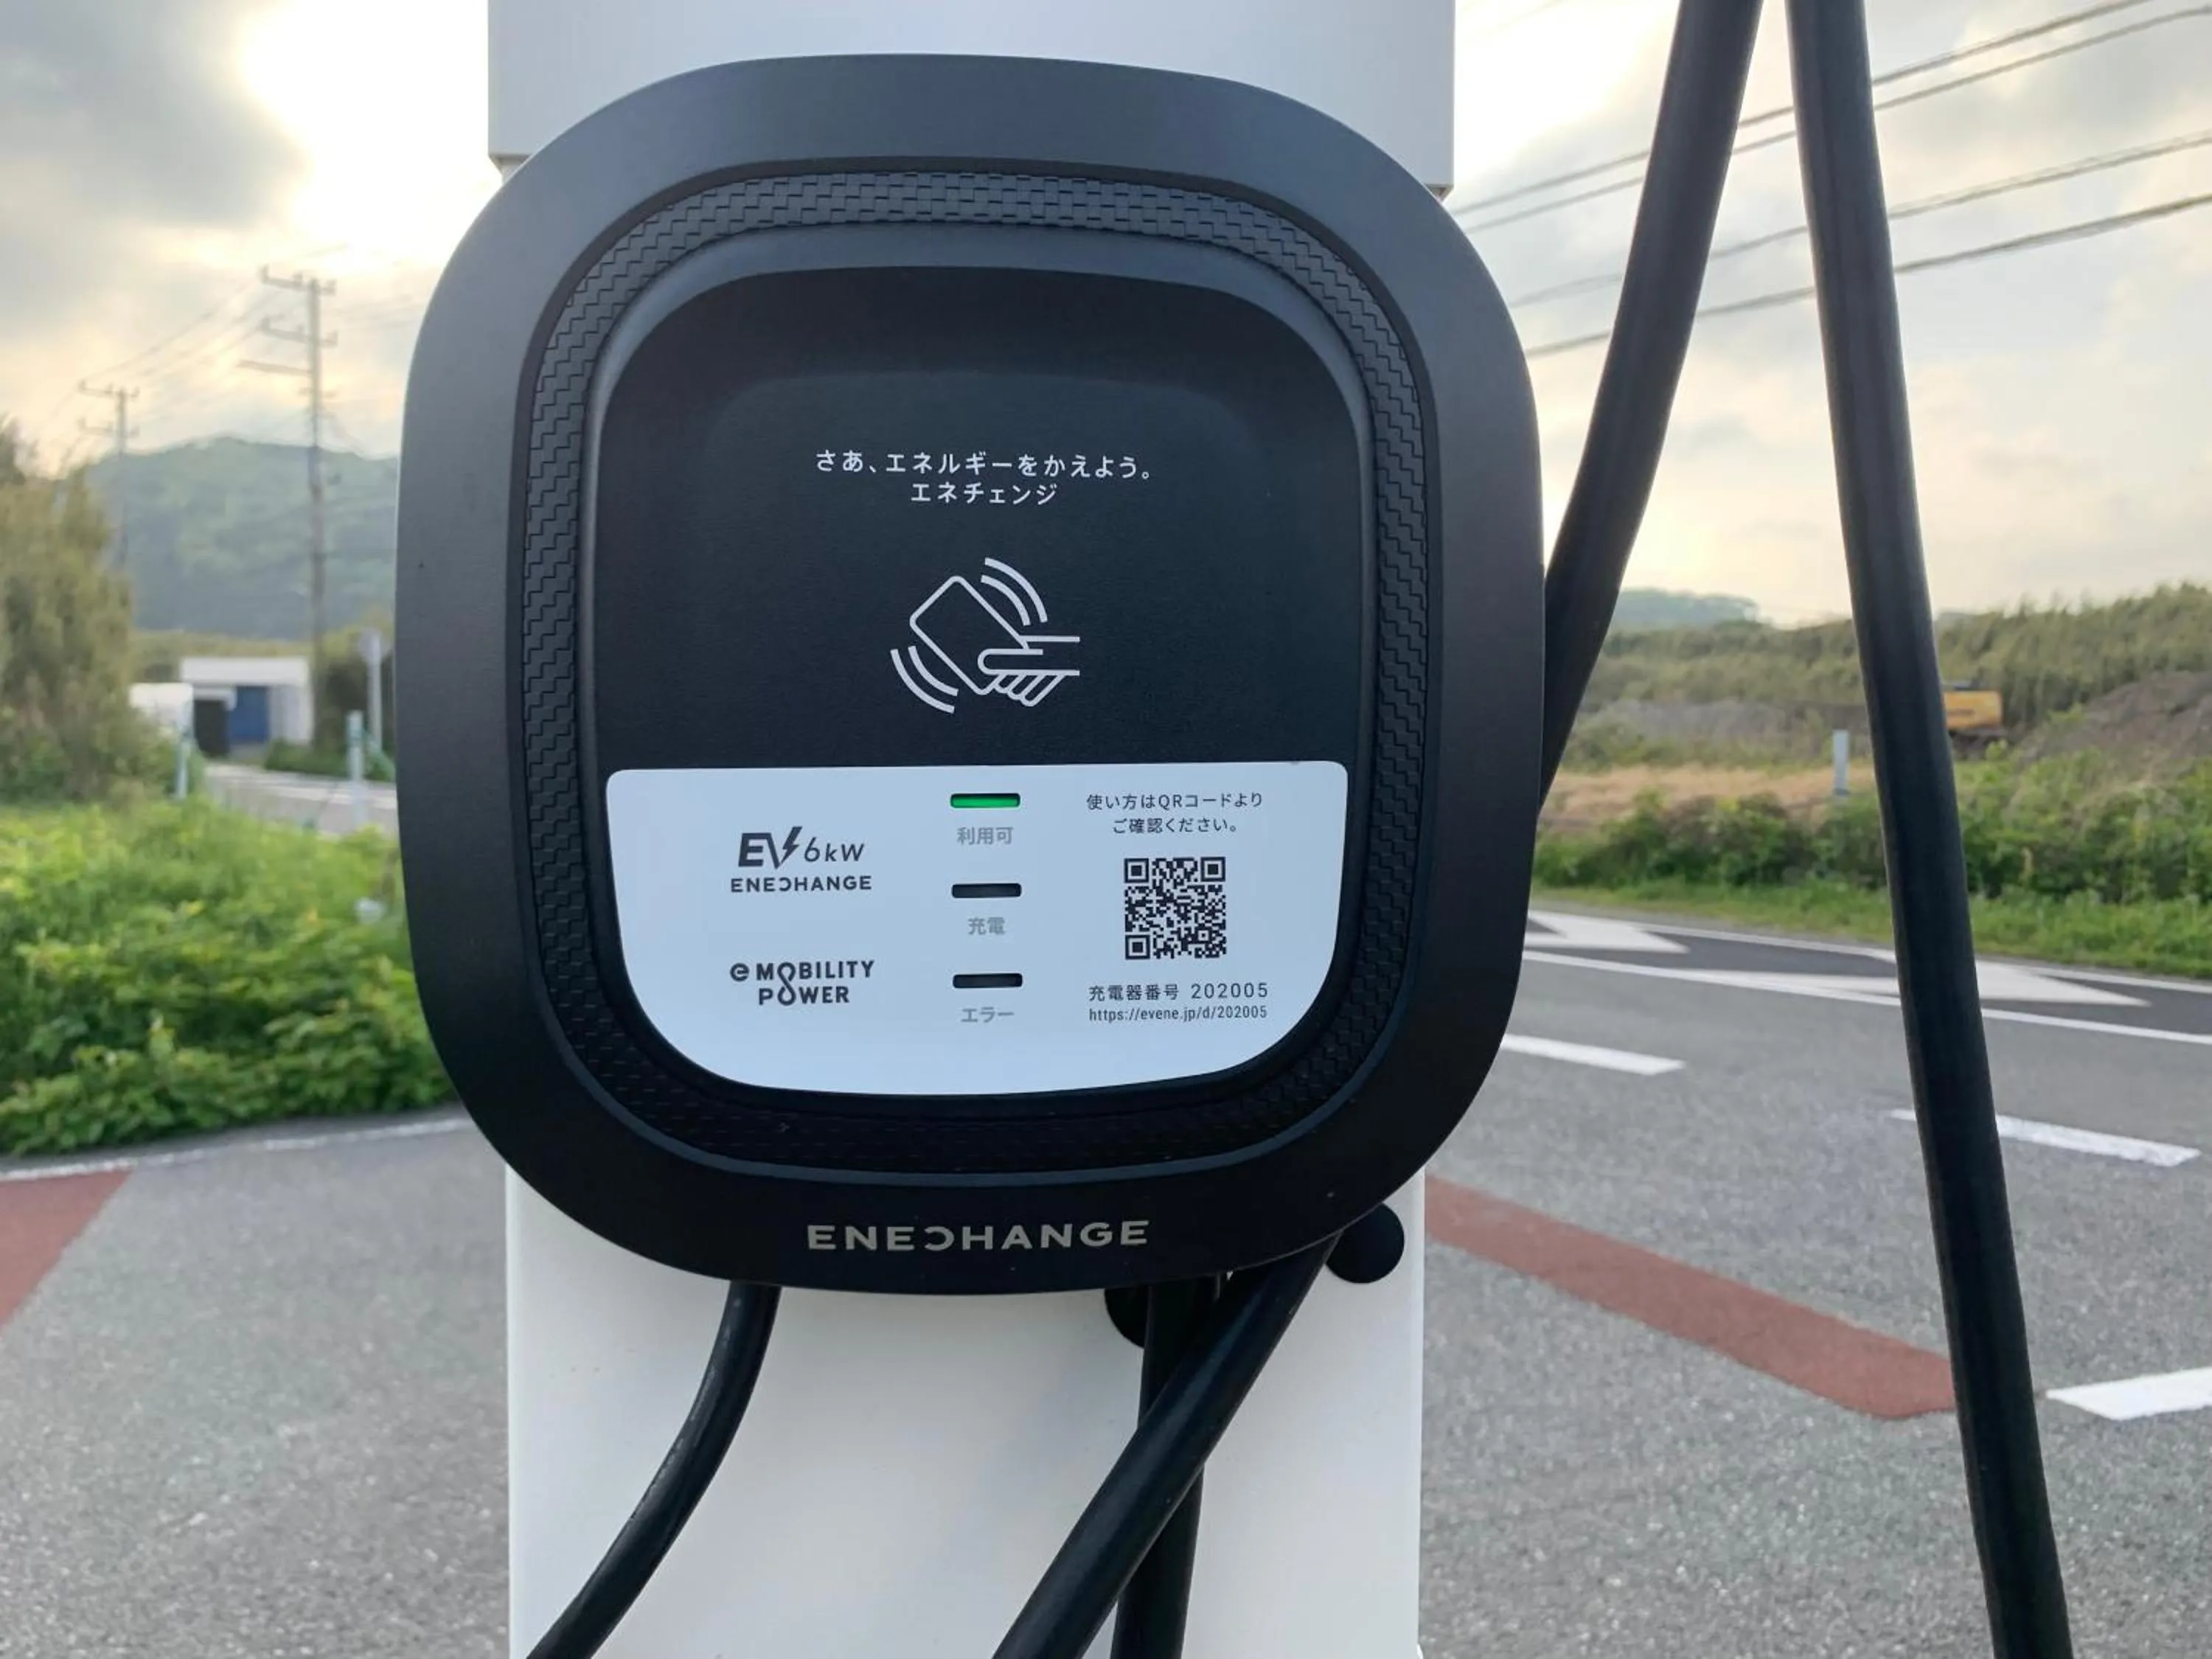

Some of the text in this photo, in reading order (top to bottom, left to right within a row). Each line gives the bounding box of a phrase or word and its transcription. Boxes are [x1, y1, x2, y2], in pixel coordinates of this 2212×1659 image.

[815, 449, 1150, 480] さあ、エネルギーをかえよう。
[911, 481, 1057, 505] エネチェンジ
[1086, 792, 1262, 811] 使い方はQRコードより
[1113, 817, 1237, 834] ご確認ください。
[957, 827, 1014, 846] 利用可
[967, 917, 1006, 936] 充電
[758, 985, 850, 1006] POWER
[1089, 982, 1267, 1002] 充電器番号 202005
[961, 1006, 1015, 1023] エラー
[1089, 1005, 1267, 1023] https://evene.jp/d/202005
